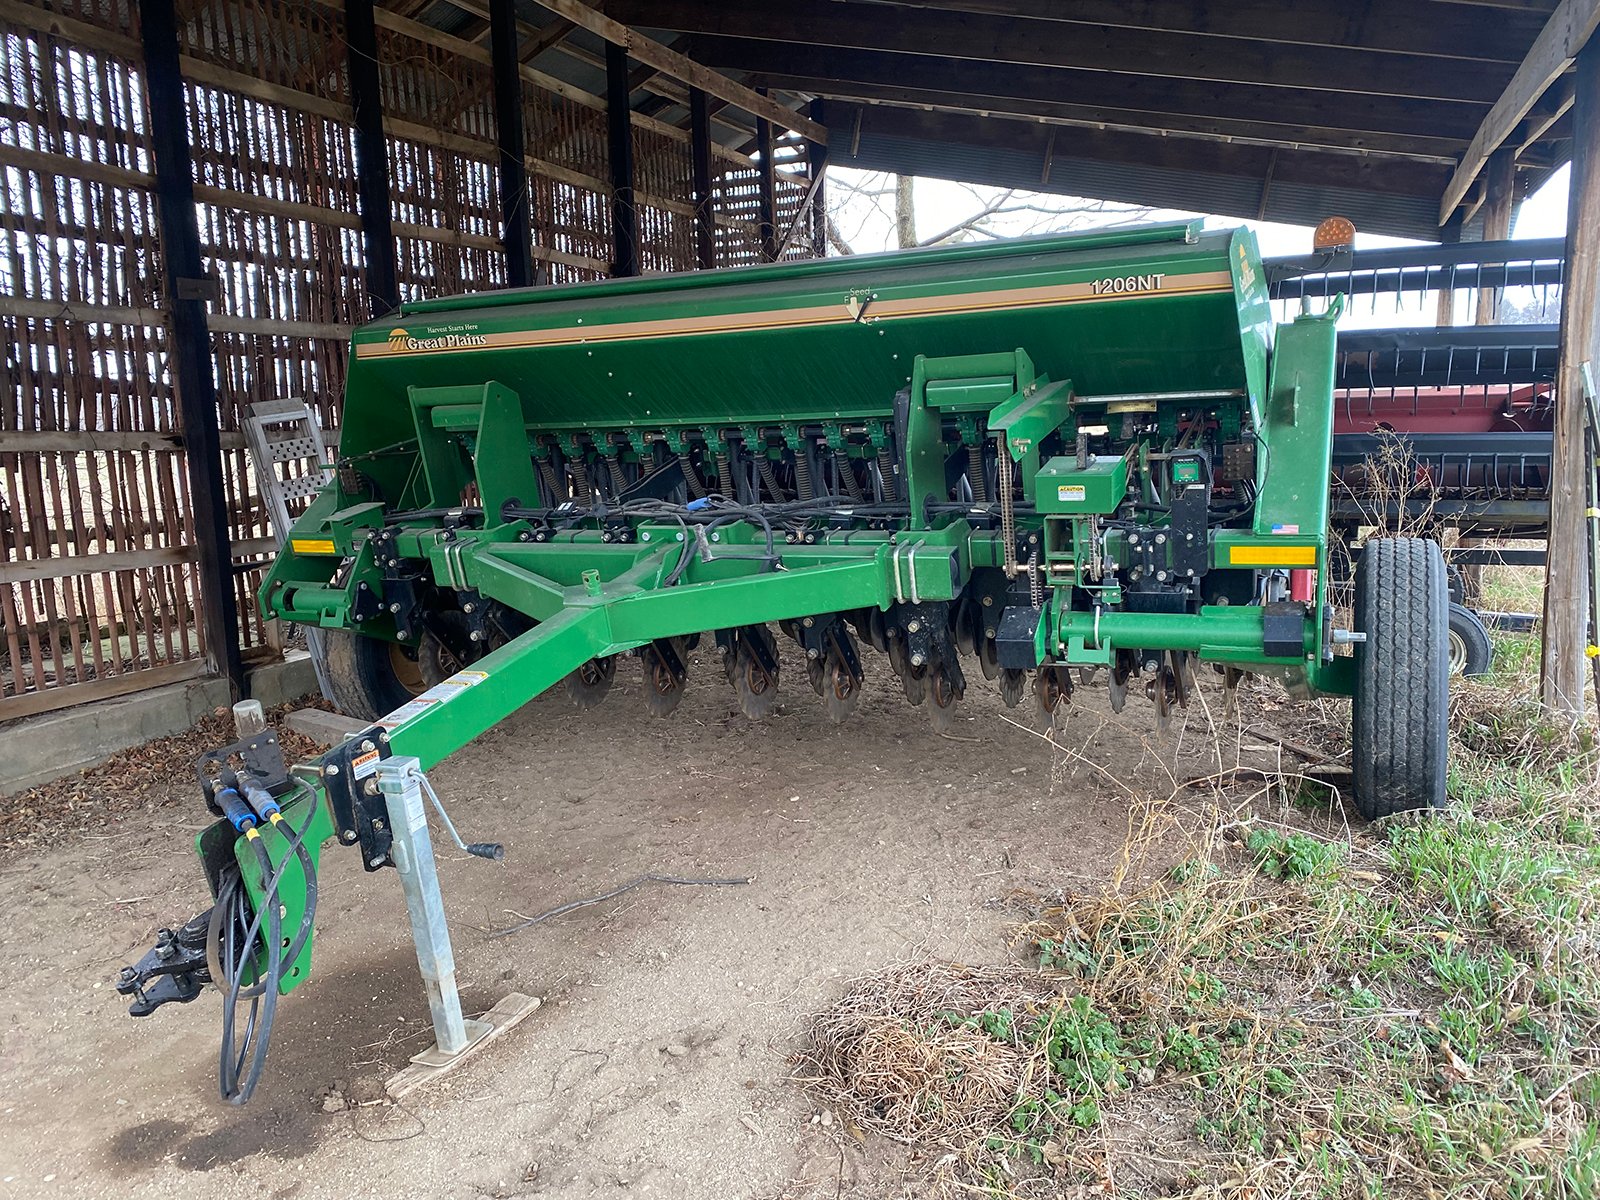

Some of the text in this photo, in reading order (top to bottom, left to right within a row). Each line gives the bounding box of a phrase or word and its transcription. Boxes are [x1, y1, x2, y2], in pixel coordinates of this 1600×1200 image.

[1091, 273, 1166, 294] 1206NT
[850, 286, 870, 296] Seed
[427, 323, 478, 334] Harvest Starts Here
[407, 333, 487, 351] Great Plains
